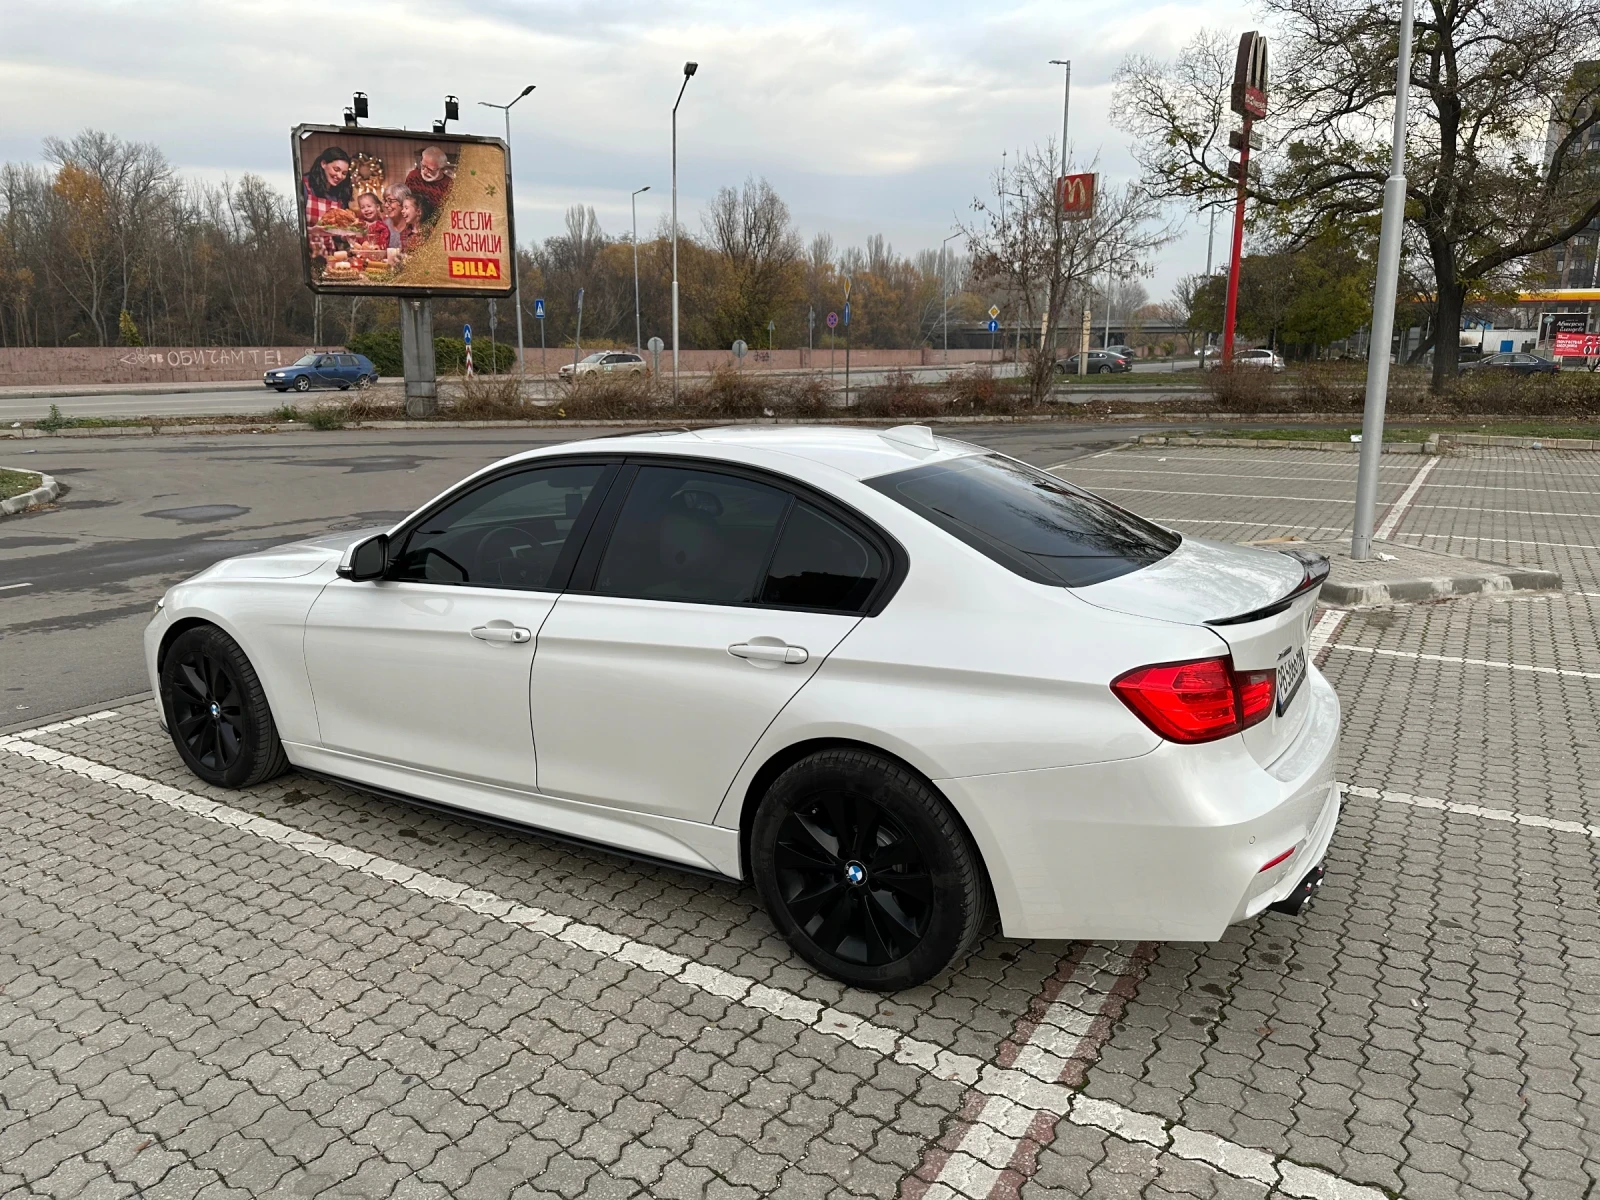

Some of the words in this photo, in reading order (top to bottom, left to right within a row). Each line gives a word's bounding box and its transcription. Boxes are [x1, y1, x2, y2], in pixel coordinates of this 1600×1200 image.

[450, 210, 493, 231] ВЕСЕЛИ
[443, 232, 502, 255] ПРАЗНИЦИ
[451, 260, 498, 277] BILLA
